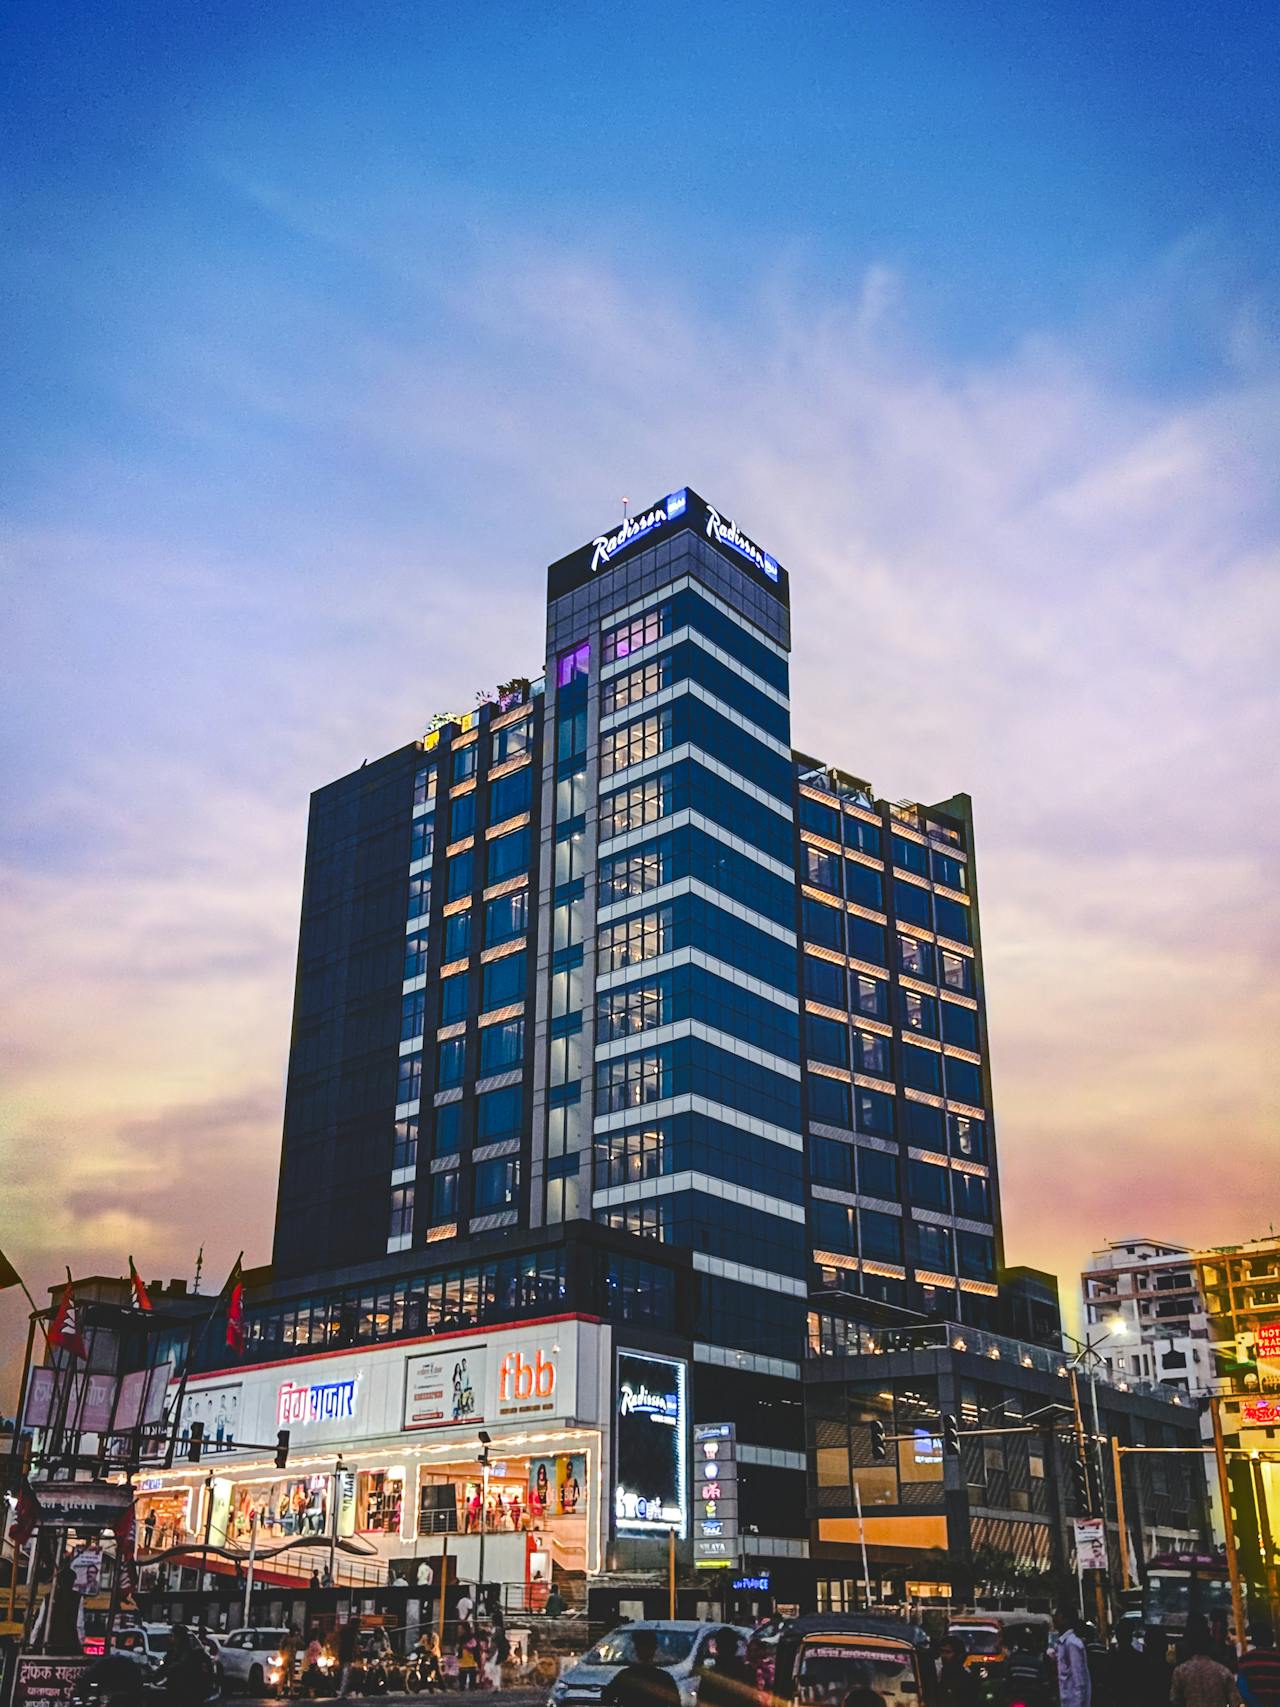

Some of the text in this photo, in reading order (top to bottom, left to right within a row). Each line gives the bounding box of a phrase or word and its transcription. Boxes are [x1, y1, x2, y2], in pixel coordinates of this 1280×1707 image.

[590, 508, 667, 572] Radisson
[705, 504, 764, 569] Radisson
[498, 1350, 557, 1401] fbb
[620, 1385, 667, 1417] Radisson
